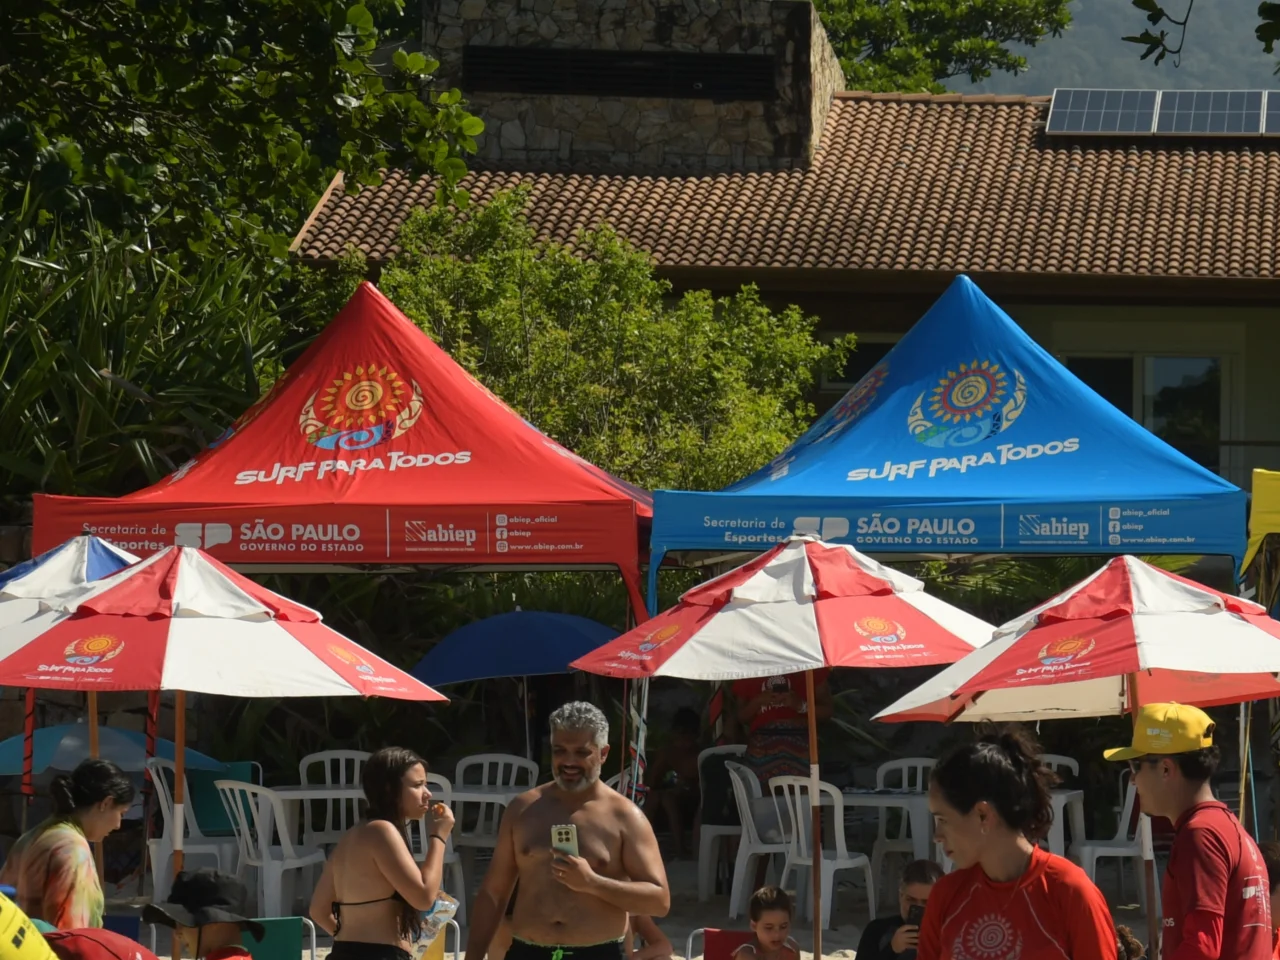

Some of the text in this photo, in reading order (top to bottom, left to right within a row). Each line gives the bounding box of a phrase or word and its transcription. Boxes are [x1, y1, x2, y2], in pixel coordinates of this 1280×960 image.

[846, 438, 1080, 482] SURF PARA TODOS
[234, 451, 472, 485] SURF PARA TODOS
[509, 515, 558, 524] abiep_oficial
[703, 516, 786, 529] Secretaria de
[856, 513, 975, 535] SÃO PAULO
[82, 522, 167, 535] Secretaria de
[240, 519, 360, 541] SÃO PAULO
[509, 529, 532, 537] abiep
[1041, 517, 1089, 540] abiep
[1122, 522, 1144, 531] abiep
[427, 524, 476, 546] abiep
[724, 532, 783, 545] Esportes
[856, 536, 979, 545] GOVERNO DO ESTADO
[240, 543, 364, 552] GOVERNO DO ESTADO
[509, 542, 584, 551] www.abiep.com.br
